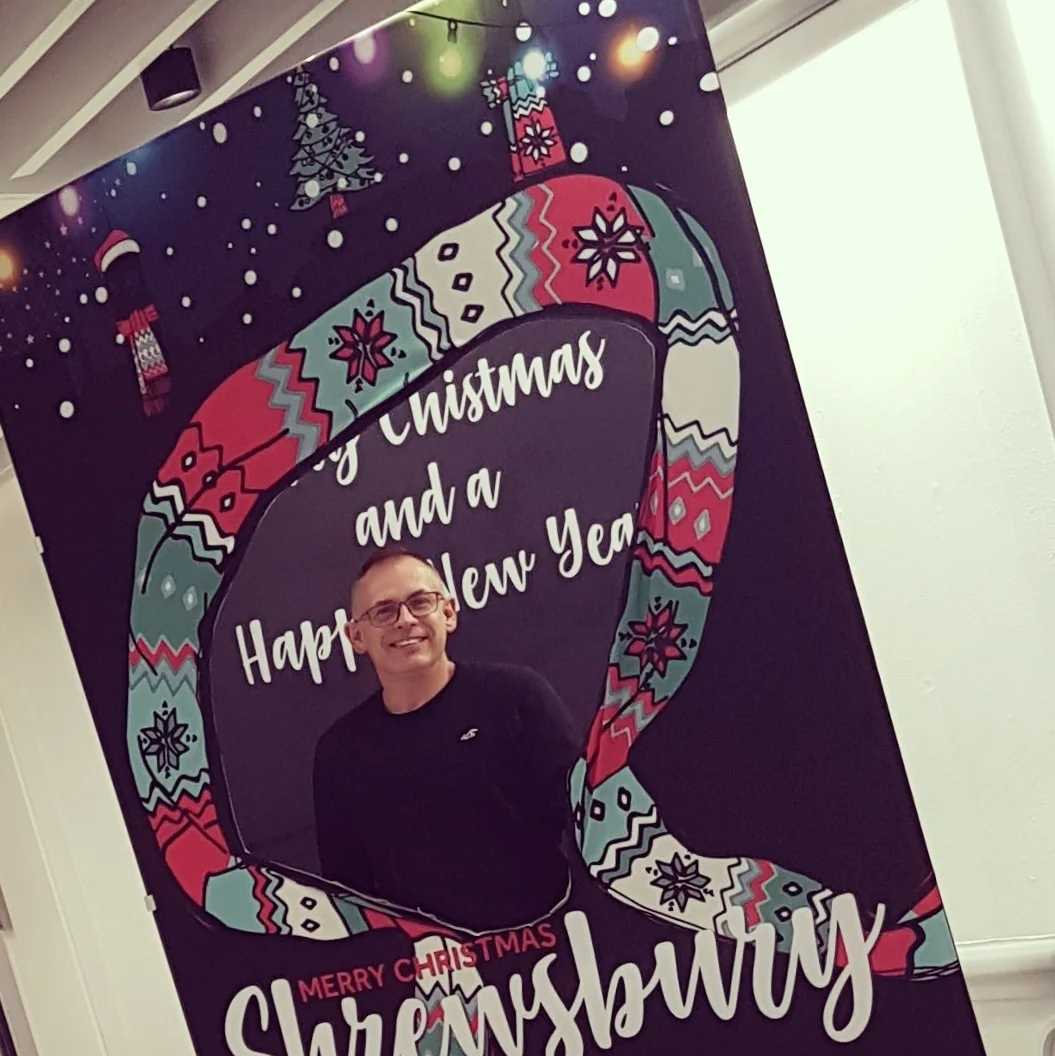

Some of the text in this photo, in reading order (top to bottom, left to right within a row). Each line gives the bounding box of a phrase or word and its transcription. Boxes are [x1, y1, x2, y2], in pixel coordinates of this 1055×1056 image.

[355, 461, 502, 547] and a
[298, 924, 557, 1002] MERRY CHRISTMAS
